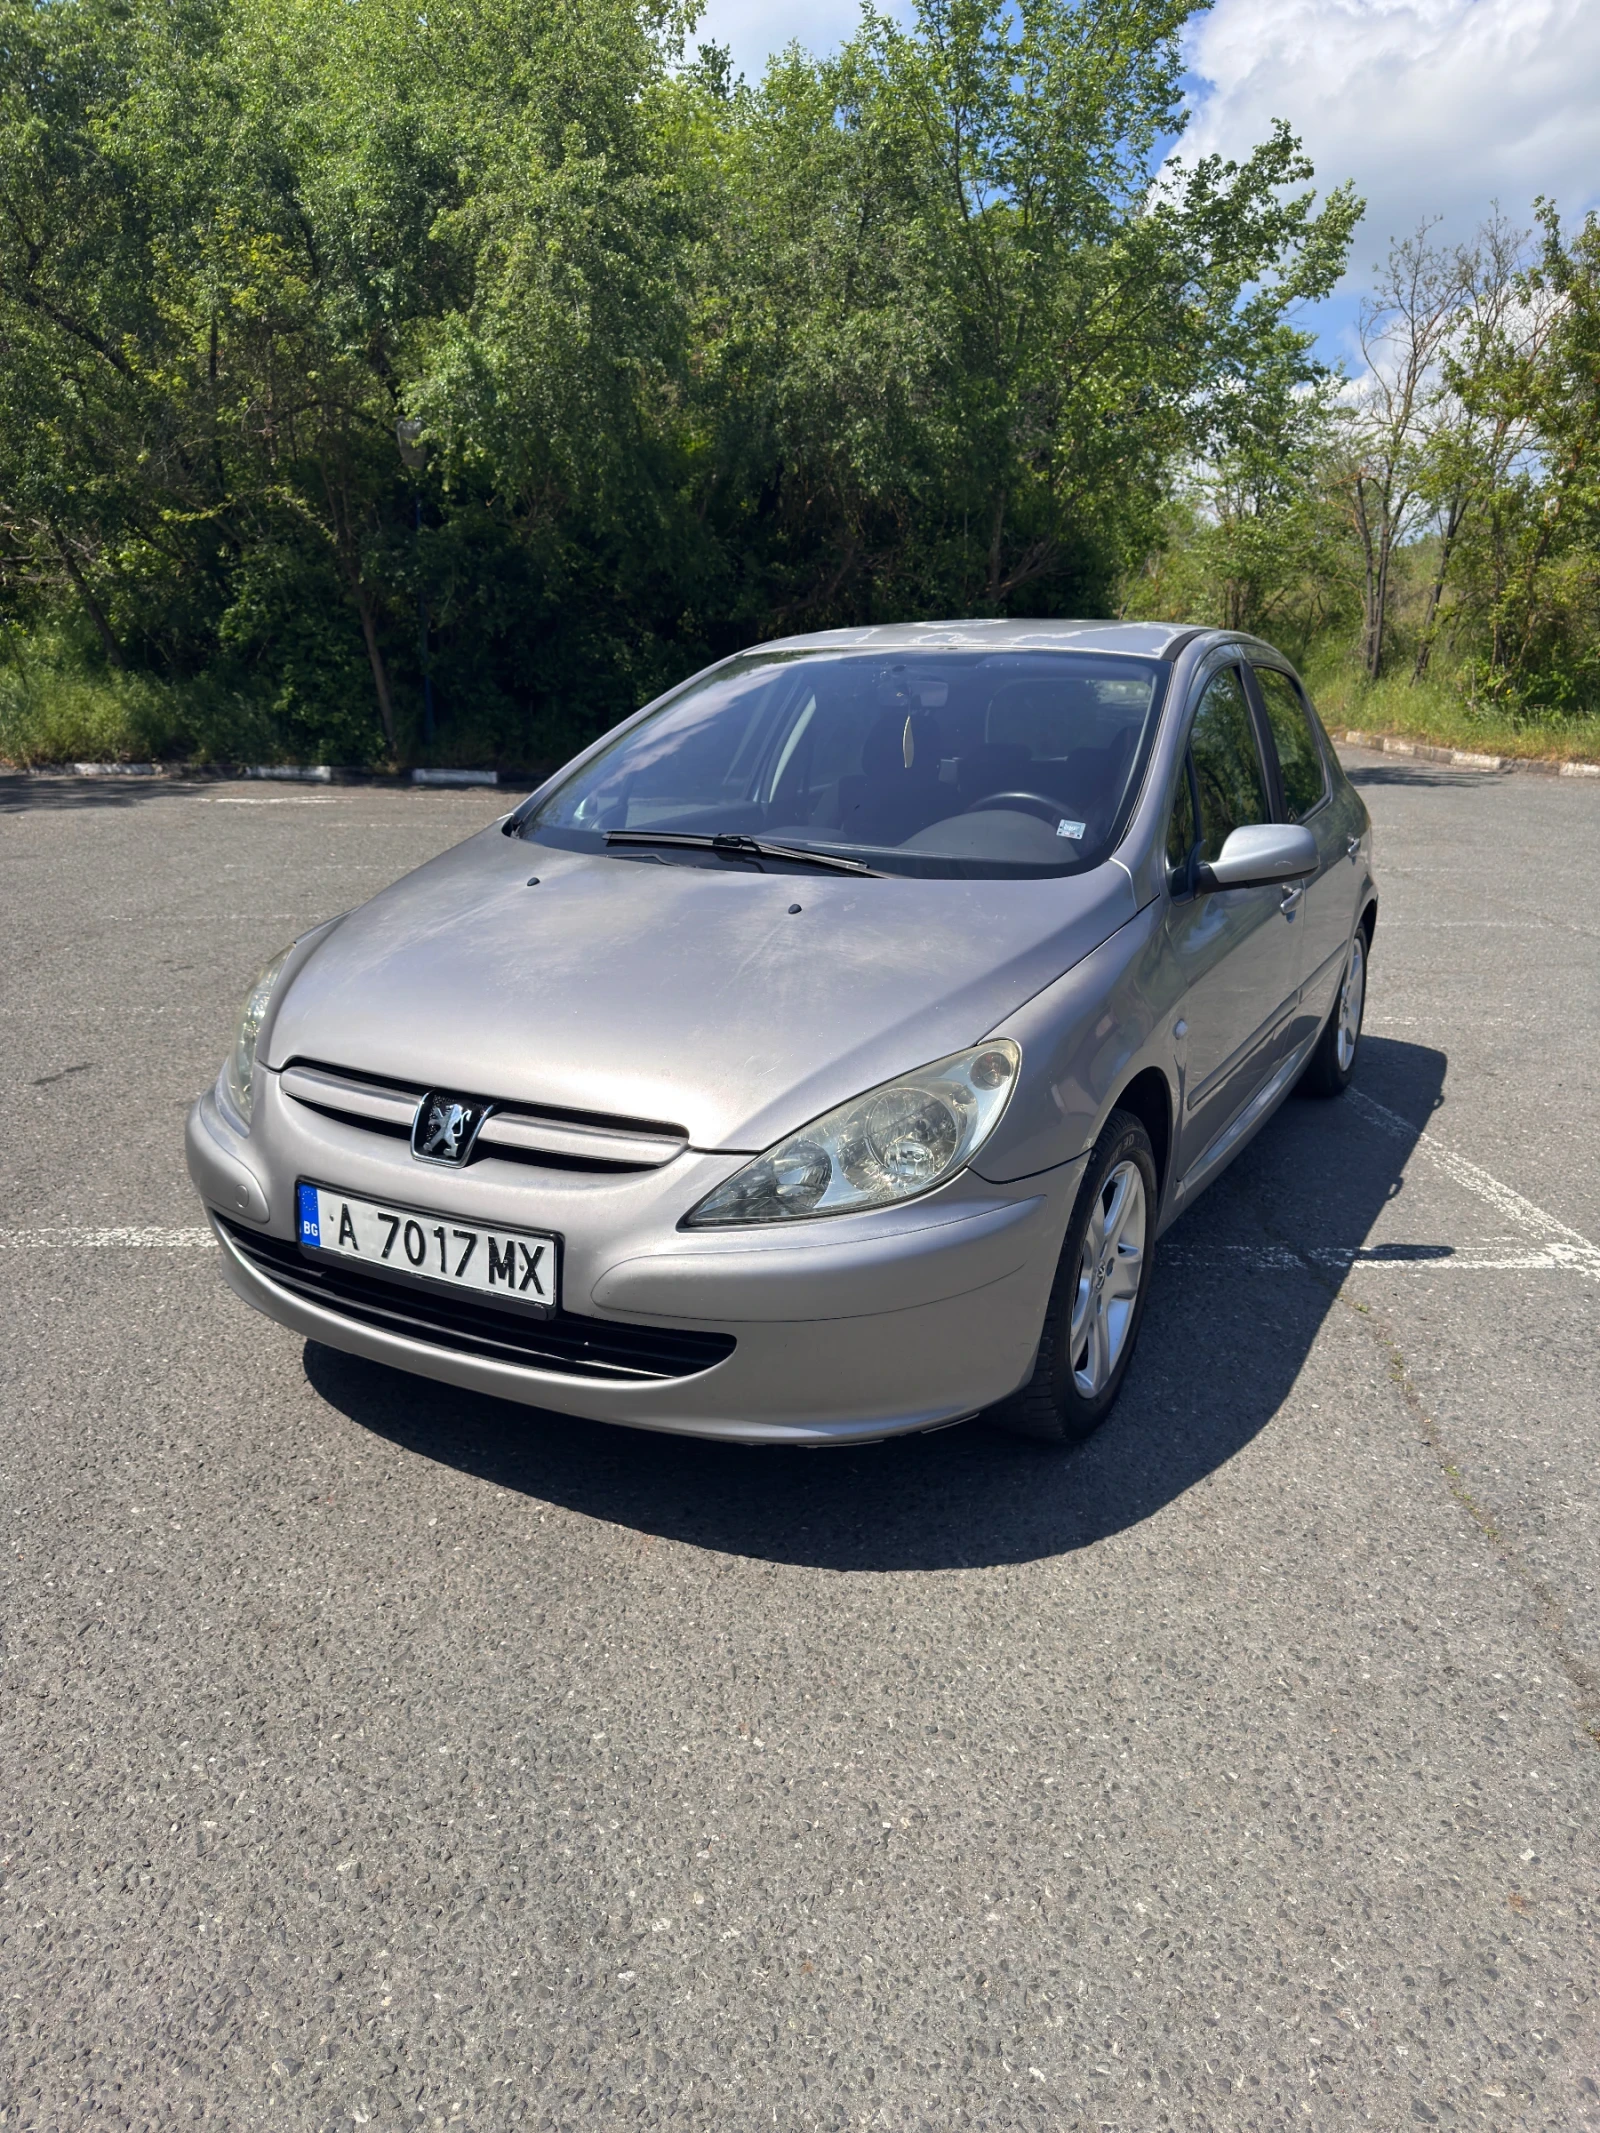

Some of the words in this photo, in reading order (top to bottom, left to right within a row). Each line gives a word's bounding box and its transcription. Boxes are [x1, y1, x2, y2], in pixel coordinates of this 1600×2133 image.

[303, 1221, 318, 1237] BG
[338, 1203, 359, 1251] A
[377, 1212, 478, 1277] 7017
[488, 1236, 546, 1295] MX
